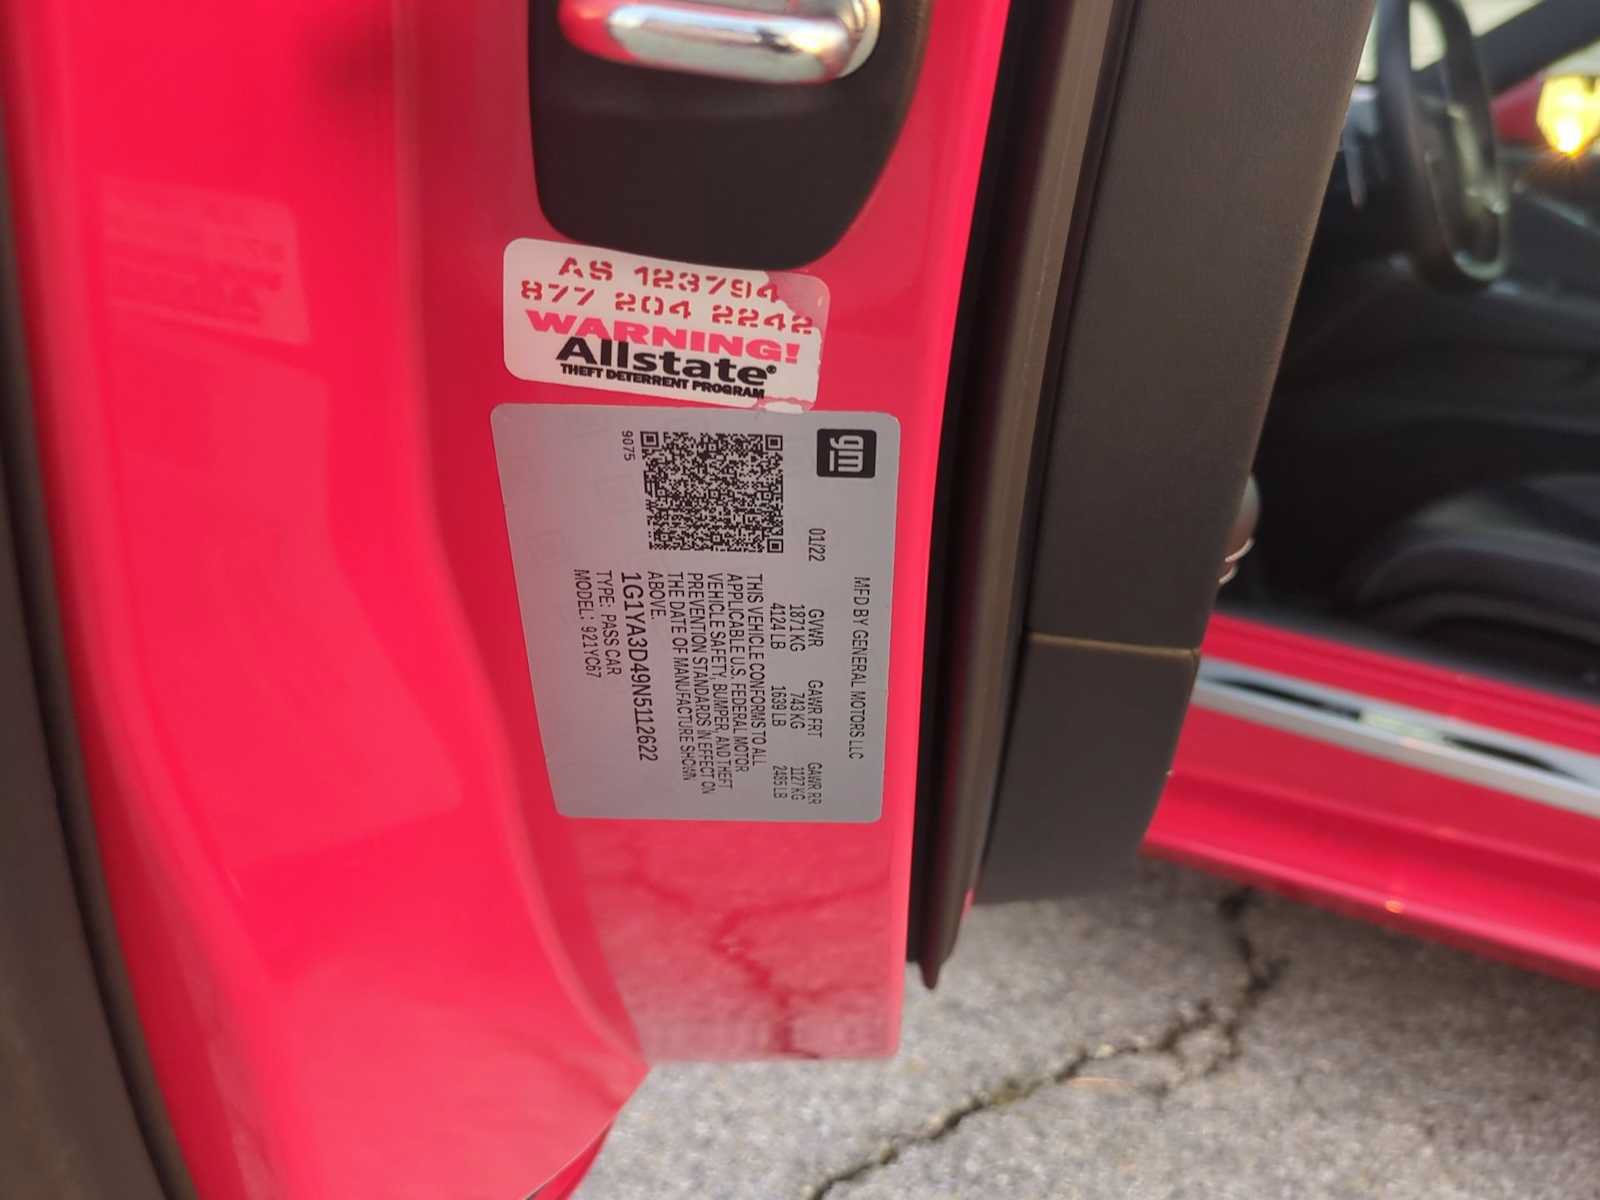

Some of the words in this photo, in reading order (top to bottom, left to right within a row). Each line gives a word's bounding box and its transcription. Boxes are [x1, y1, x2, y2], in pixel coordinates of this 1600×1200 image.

[558, 257, 613, 281] AS
[634, 266, 779, 303] 123794
[520, 280, 595, 306] 877
[614, 292, 692, 320] 204
[711, 304, 814, 335] 2242
[525, 309, 801, 364] WARNING!
[560, 363, 603, 379] THEFT
[606, 370, 690, 391] DETERRENT
[692, 380, 765, 399] PROGRAM
[621, 430, 636, 461] 9075
[829, 435, 864, 472] gm
[808, 528, 826, 562] 01/22
[573, 569, 593, 620] MODEL:
[596, 569, 615, 608] TYPE:
[648, 571, 667, 620] ABOVE.
[667, 572, 684, 597] THE
[707, 572, 725, 630] VEHICLE
[747, 573, 764, 603] THIS
[853, 576, 871, 605] MFD
[669, 601, 687, 634] DATE
[687, 572, 707, 653] PREVENTION
[727, 572, 745, 653] APPLICABLE
[770, 602, 786, 631] 4124
[789, 604, 806, 633] 1871
[808, 608, 824, 648] GVWR
[853, 609, 869, 625] BY
[601, 614, 620, 647] PASS
[672, 637, 688, 654] OF
[748, 604, 764, 660] VEHICLE
[771, 634, 786, 650] LB
[790, 635, 806, 652] KG
[581, 626, 602, 679] 921YC67
[605, 649, 622, 676] CAR
[621, 572, 658, 762] 1G1YA3D49N5112622
[730, 656, 746, 680] U.S.
[850, 629, 869, 688] GENERAL
[673, 657, 694, 742] MANUFACTURE
[692, 655, 711, 726] STANDARDS
[750, 663, 766, 728] CONFORMS
[771, 685, 787, 711] 1639
[790, 692, 805, 712] 743
[808, 680, 823, 716] GAWR
[731, 683, 747, 733] FEDERAL
[771, 713, 786, 728] LB
[790, 714, 805, 729] KG
[849, 691, 866, 737] MOTORS
[697, 729, 712, 739] IN
[751, 730, 767, 745] TO
[808, 718, 823, 739] FRT
[698, 741, 714, 778] EFFECT
[715, 736, 731, 757] AND
[734, 736, 749, 773] MOTOR
[752, 748, 767, 766] ALL
[849, 740, 864, 759] LLC
[701, 780, 716, 794] ON
[717, 759, 733, 790] THEFT
[808, 762, 823, 791] GAWR
